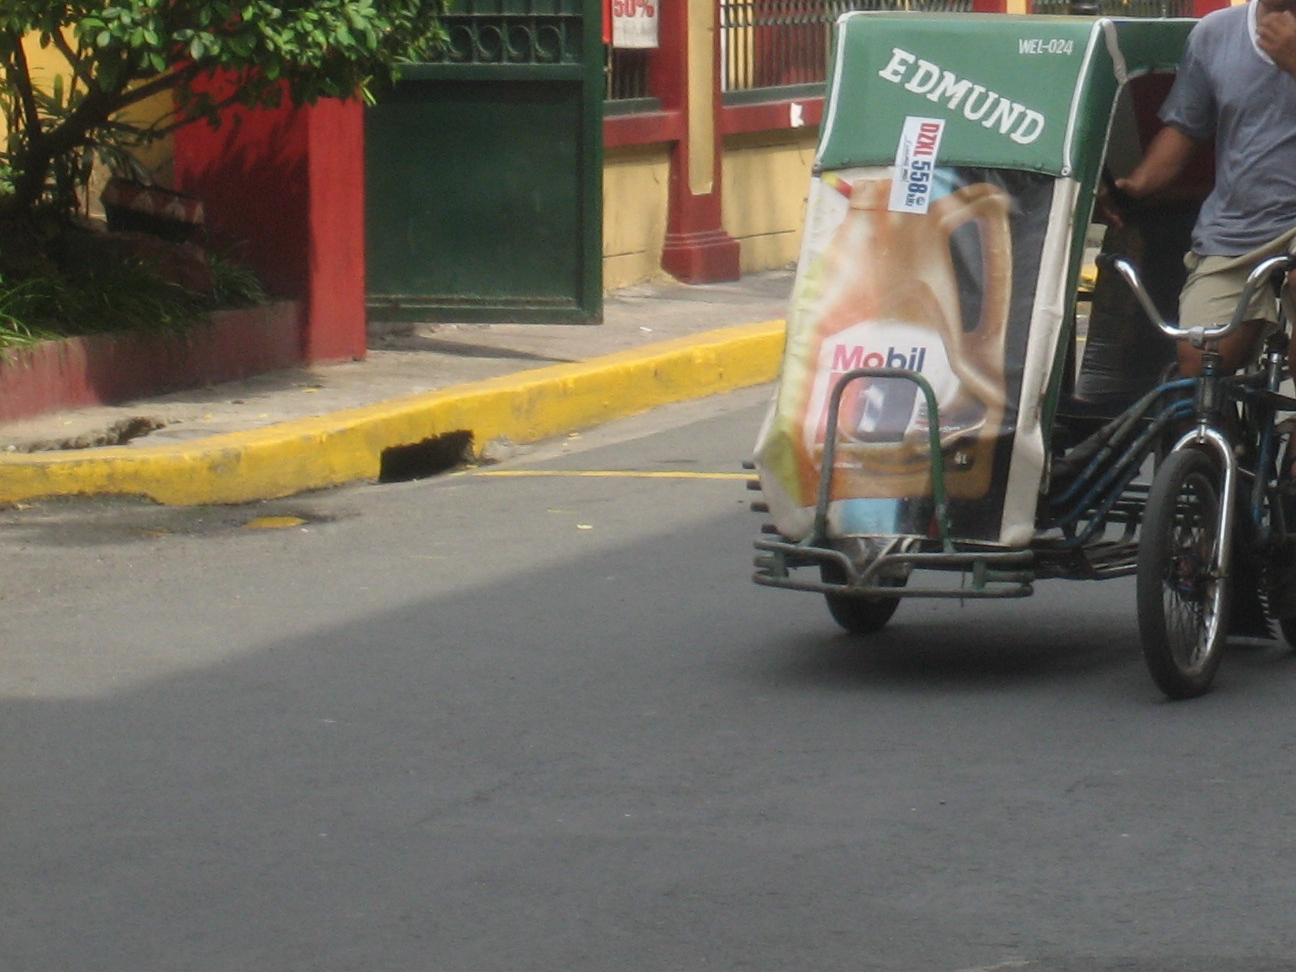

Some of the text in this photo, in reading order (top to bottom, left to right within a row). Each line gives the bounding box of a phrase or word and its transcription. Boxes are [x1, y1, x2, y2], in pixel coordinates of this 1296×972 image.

[1019, 38, 1073, 55] WEL-024
[878, 47, 1045, 145] EDMUND
[913, 123, 941, 157] DZXL
[907, 160, 931, 194] 558
[831, 344, 927, 373] Mobil
